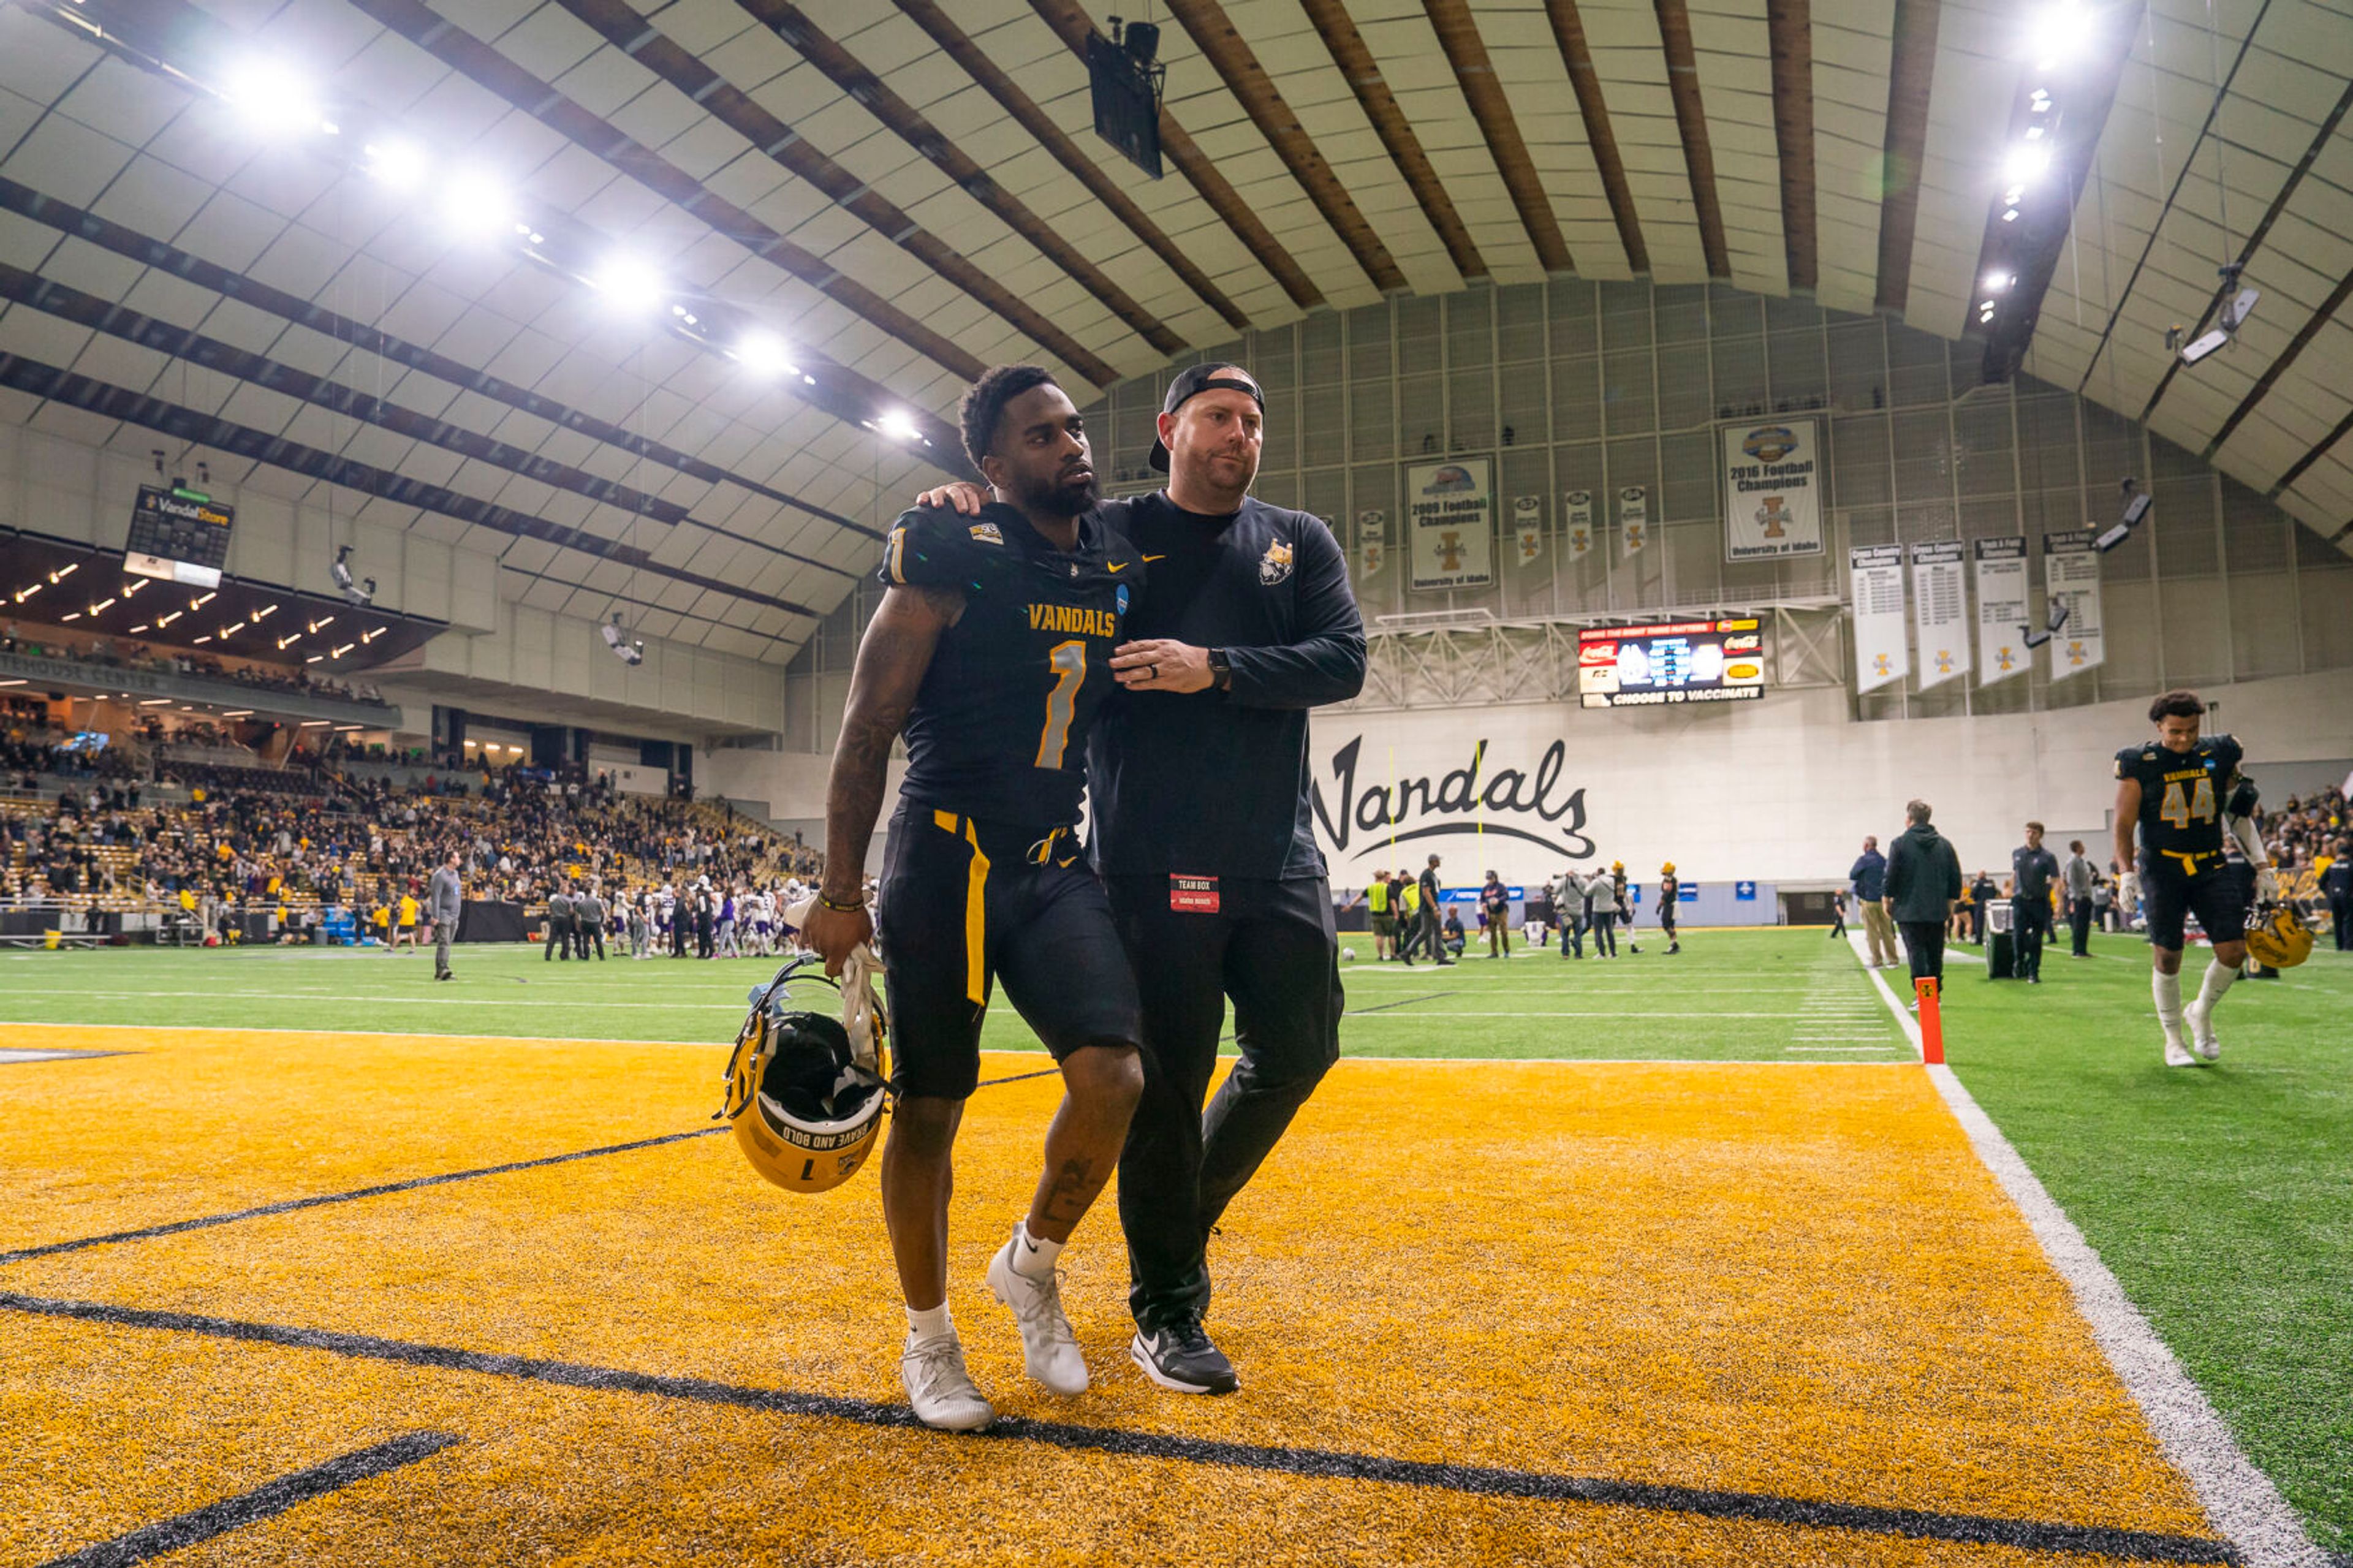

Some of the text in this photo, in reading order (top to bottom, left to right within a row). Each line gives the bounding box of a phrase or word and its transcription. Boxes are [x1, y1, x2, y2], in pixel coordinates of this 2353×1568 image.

[1730, 460, 1813, 480] 2016 Football
[1737, 476, 1808, 492] Champions
[159, 497, 229, 526] VandalStore
[1443, 498, 1487, 512] Football
[1419, 512, 1480, 528] Champions
[892, 527, 907, 584] 1
[1792, 542, 1818, 551] Idaho
[1028, 604, 1116, 638] VANDALS
[1034, 640, 1087, 770] 1
[1613, 691, 1665, 705] CHOOSE
[1667, 691, 1685, 703] TO
[1688, 687, 1760, 701] VACCINATE
[2163, 767, 2208, 782] VANDALS
[1312, 734, 1596, 860] Vandals
[2160, 777, 2216, 829] 44
[1178, 880, 1210, 890] TEAM BOX
[782, 1122, 869, 1148] BRAVE AND BOLD
[800, 1158, 815, 1181] 1
